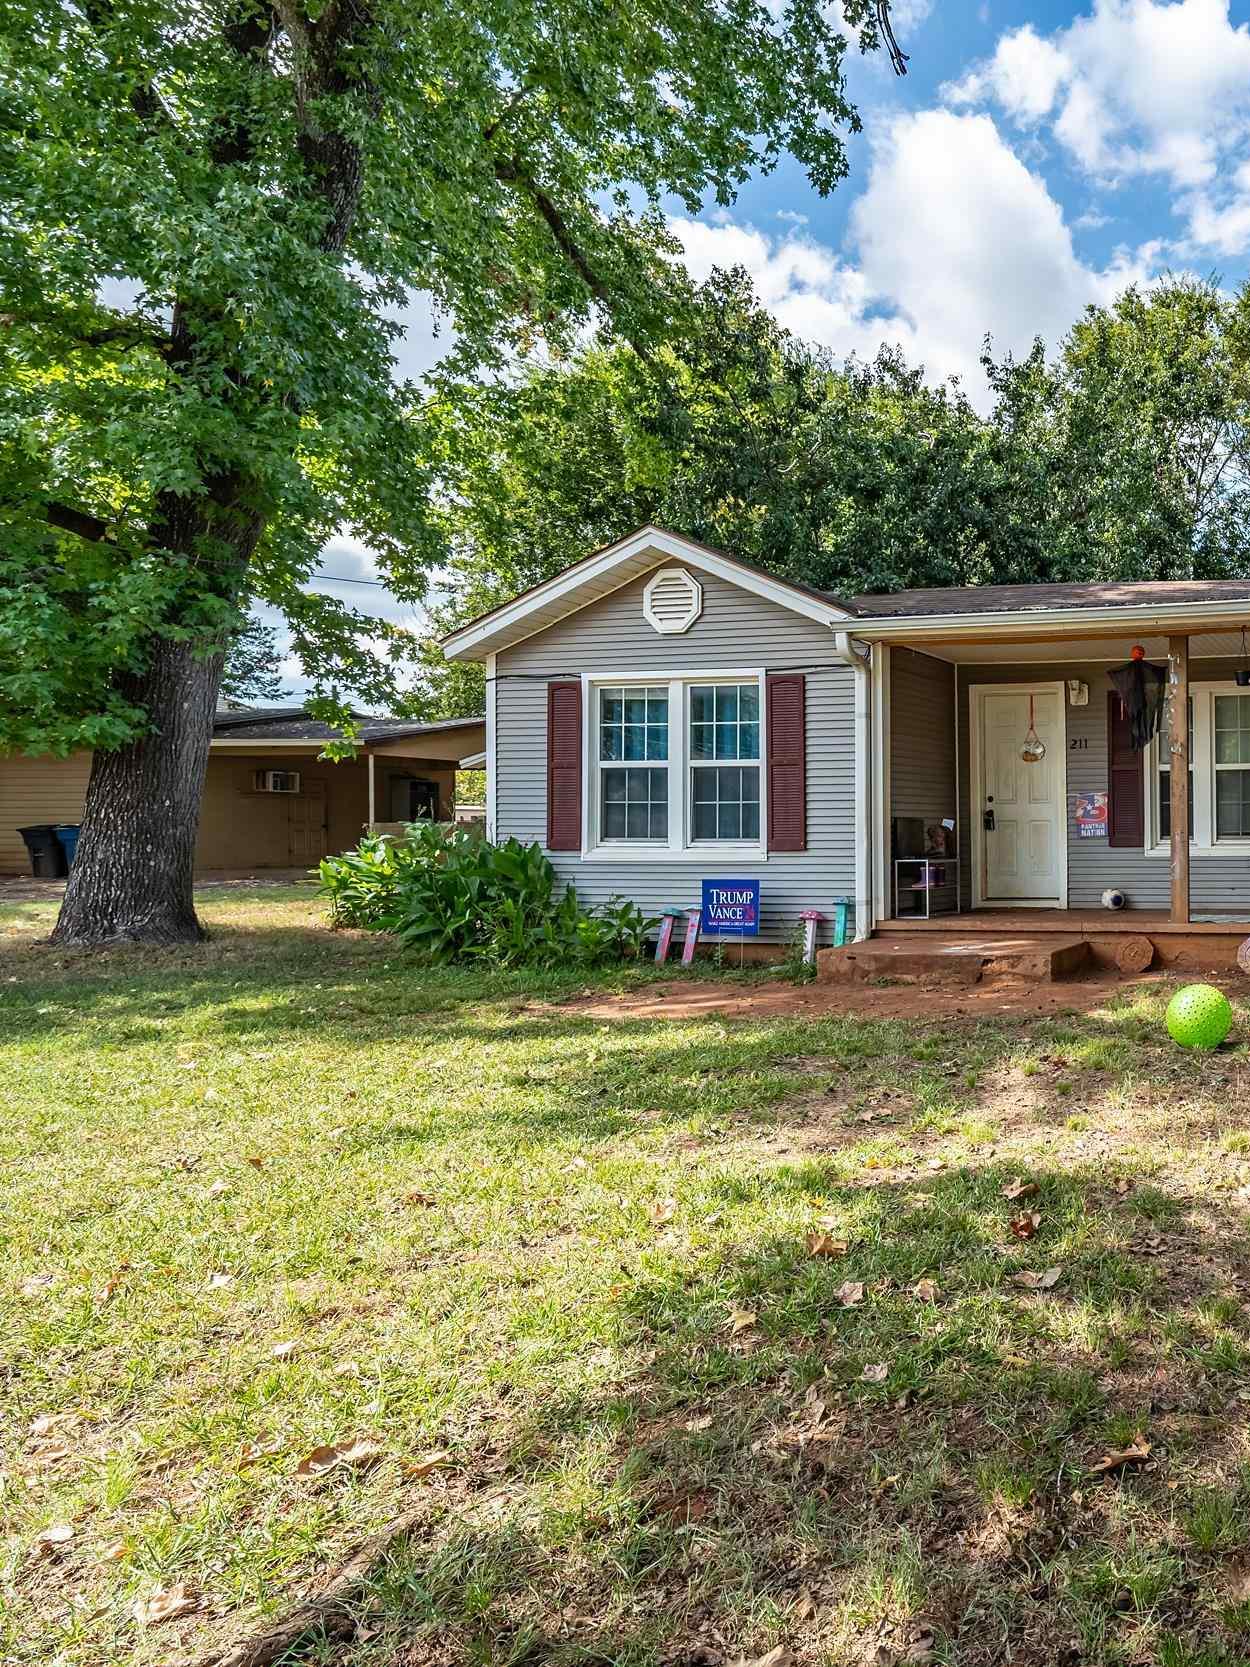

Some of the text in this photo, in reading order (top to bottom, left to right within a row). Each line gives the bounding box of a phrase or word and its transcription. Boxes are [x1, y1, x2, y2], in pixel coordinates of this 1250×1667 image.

[1070, 739, 1087, 749] 211
[710, 889, 754, 904] TRUMP
[708, 904, 744, 919] VANCE
